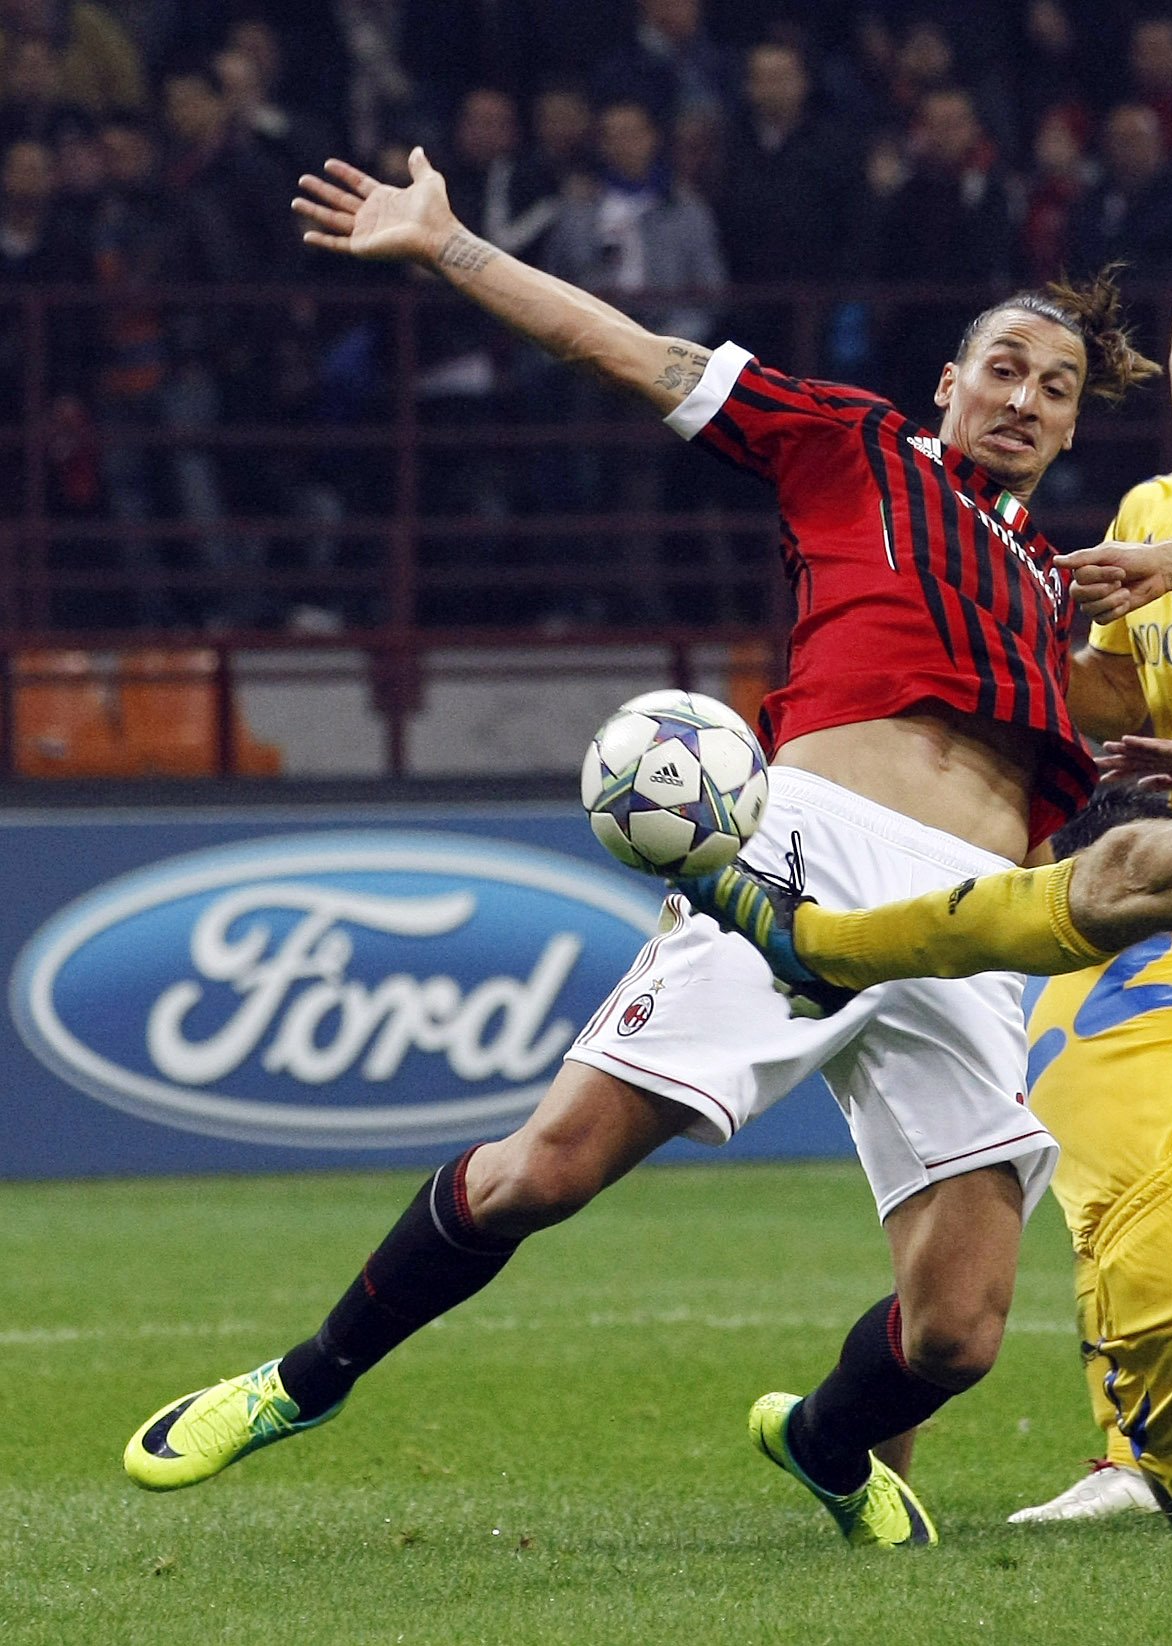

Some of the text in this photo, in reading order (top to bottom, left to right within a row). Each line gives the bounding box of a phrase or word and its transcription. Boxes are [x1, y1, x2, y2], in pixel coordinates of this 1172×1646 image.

[907, 436, 943, 466] adidas
[650, 775, 684, 788] adidas
[145, 883, 584, 1086] Ford
